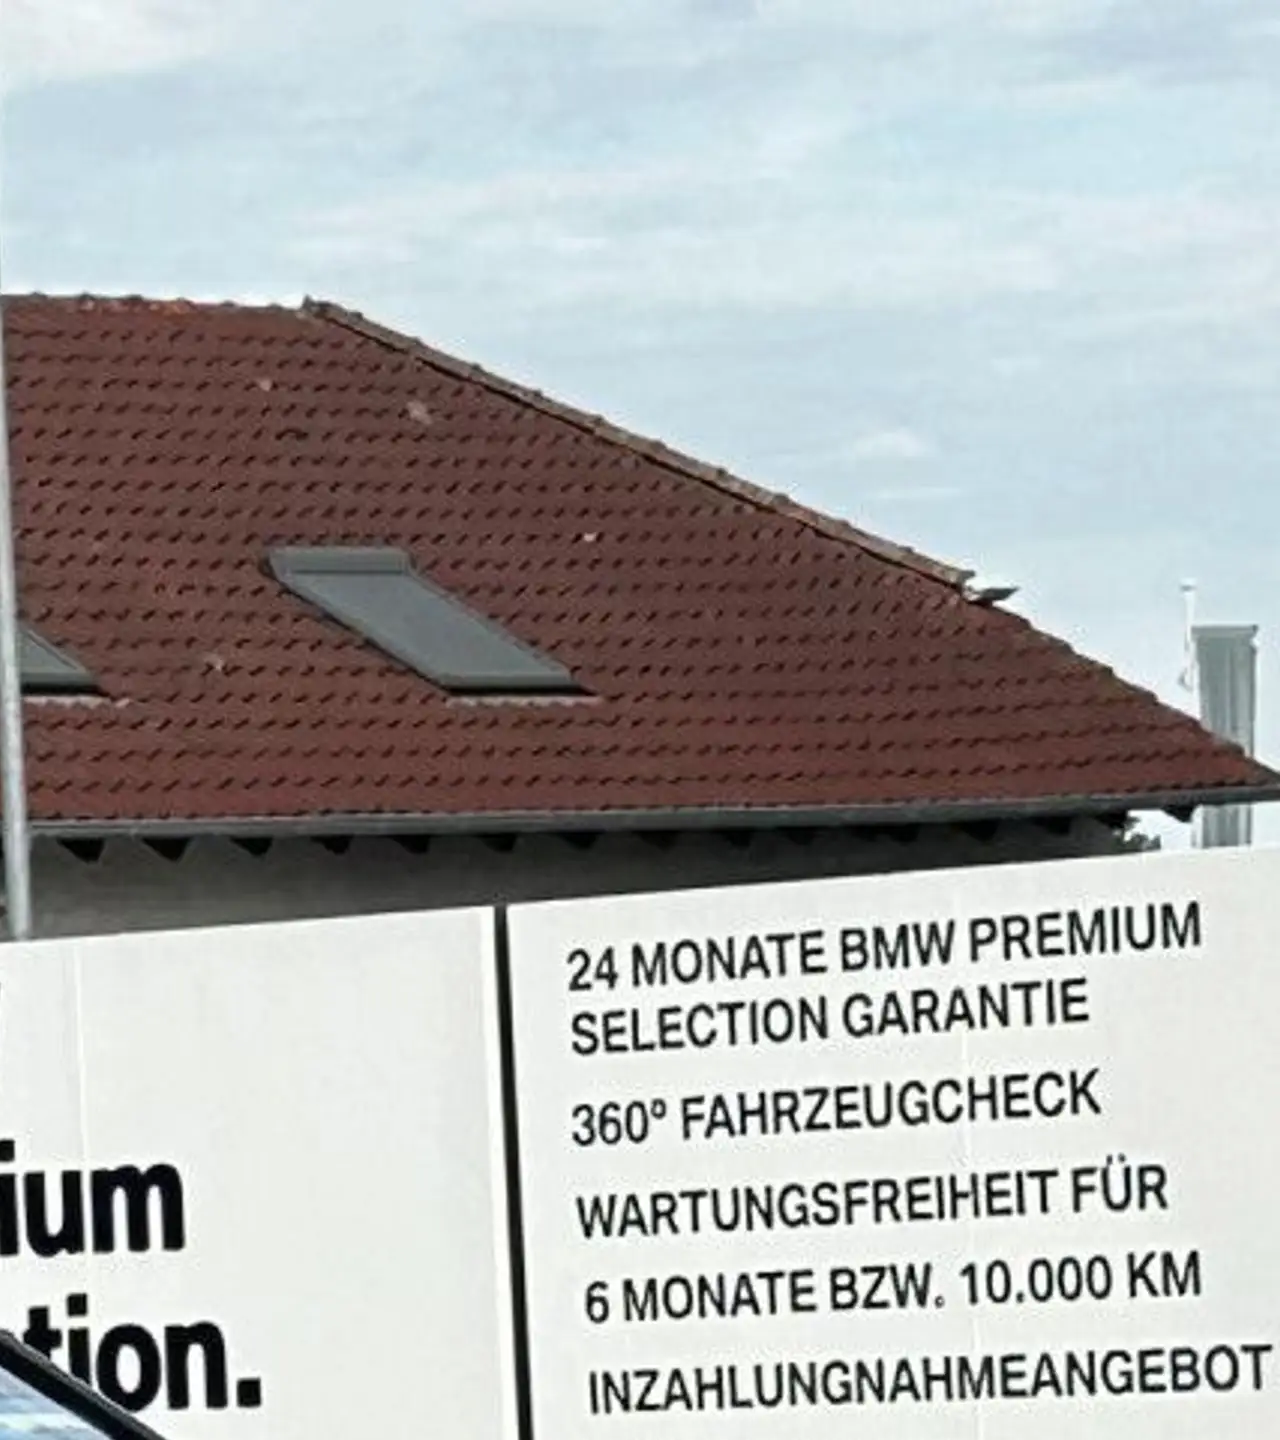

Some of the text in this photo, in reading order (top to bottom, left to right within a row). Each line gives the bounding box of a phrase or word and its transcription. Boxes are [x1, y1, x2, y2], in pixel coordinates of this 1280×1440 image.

[567, 901, 1201, 991] 24 MONATE BMW PREMIUM
[571, 978, 1090, 1056] SELECTION GARANTIE
[681, 1068, 1101, 1140] FAHRZEUGCHECK
[576, 1153, 1168, 1239] WARTUNGSFREIHEIT FÜR
[586, 1250, 1201, 1324] 6 MONATE BZW. 10.000 KM
[589, 1344, 1273, 1414] INZAHLUNGNAHMEANGEBOT
